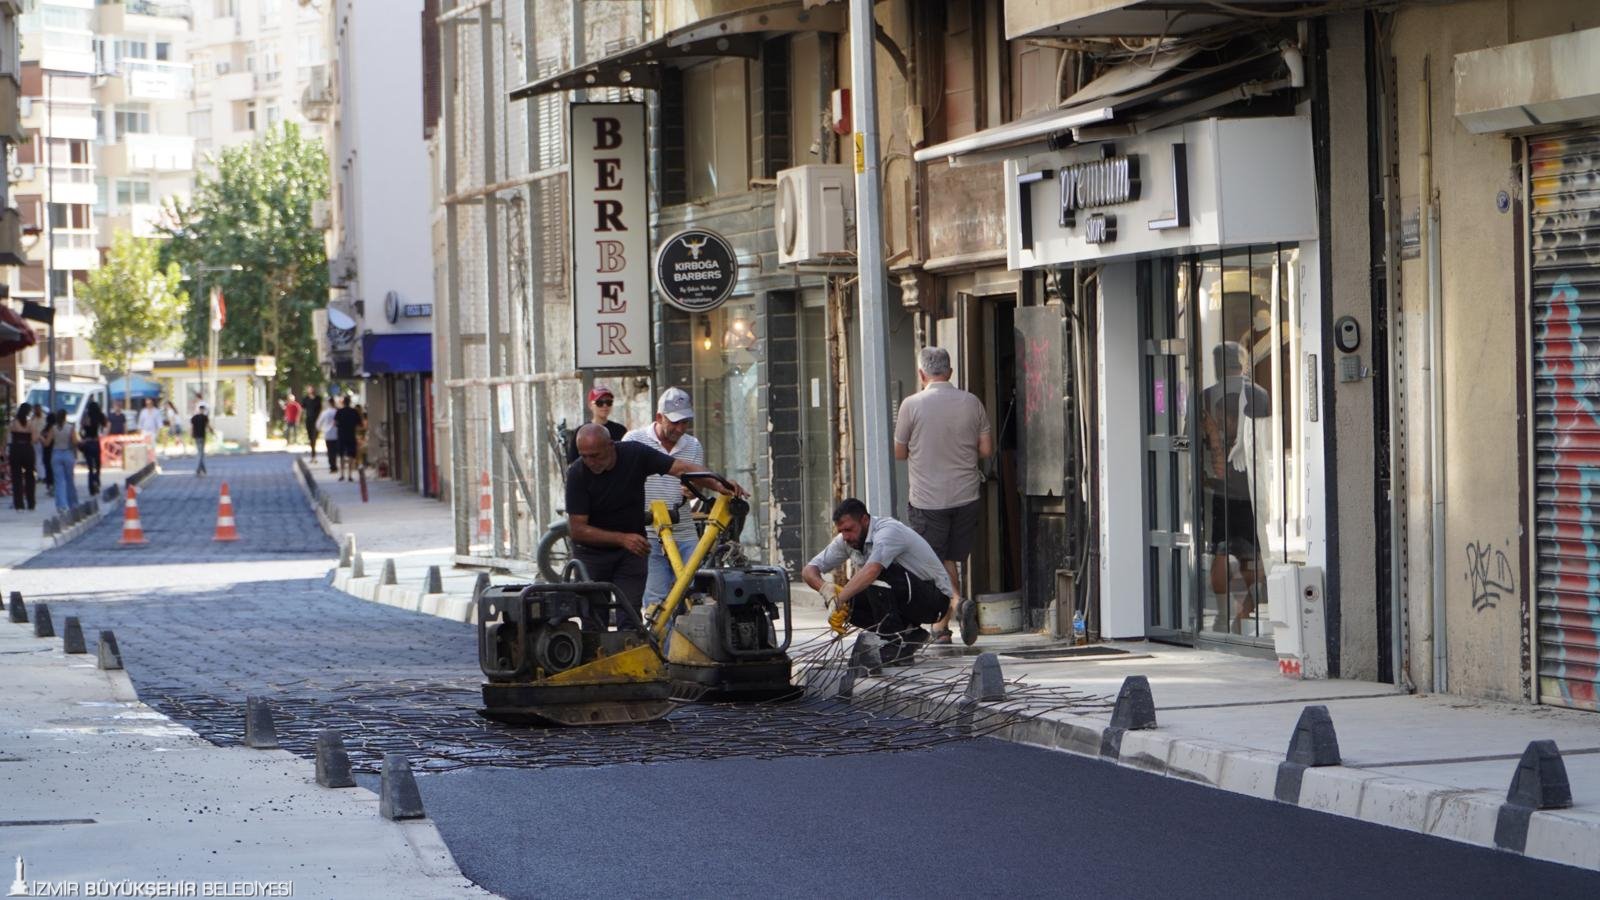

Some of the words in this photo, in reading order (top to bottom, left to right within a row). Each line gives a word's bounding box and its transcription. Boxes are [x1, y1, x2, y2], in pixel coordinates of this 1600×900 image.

[1059, 145, 1136, 228] premium
[593, 117, 631, 355] BERBER
[1086, 213, 1112, 244] store
[673, 270, 722, 282] BARBERS
